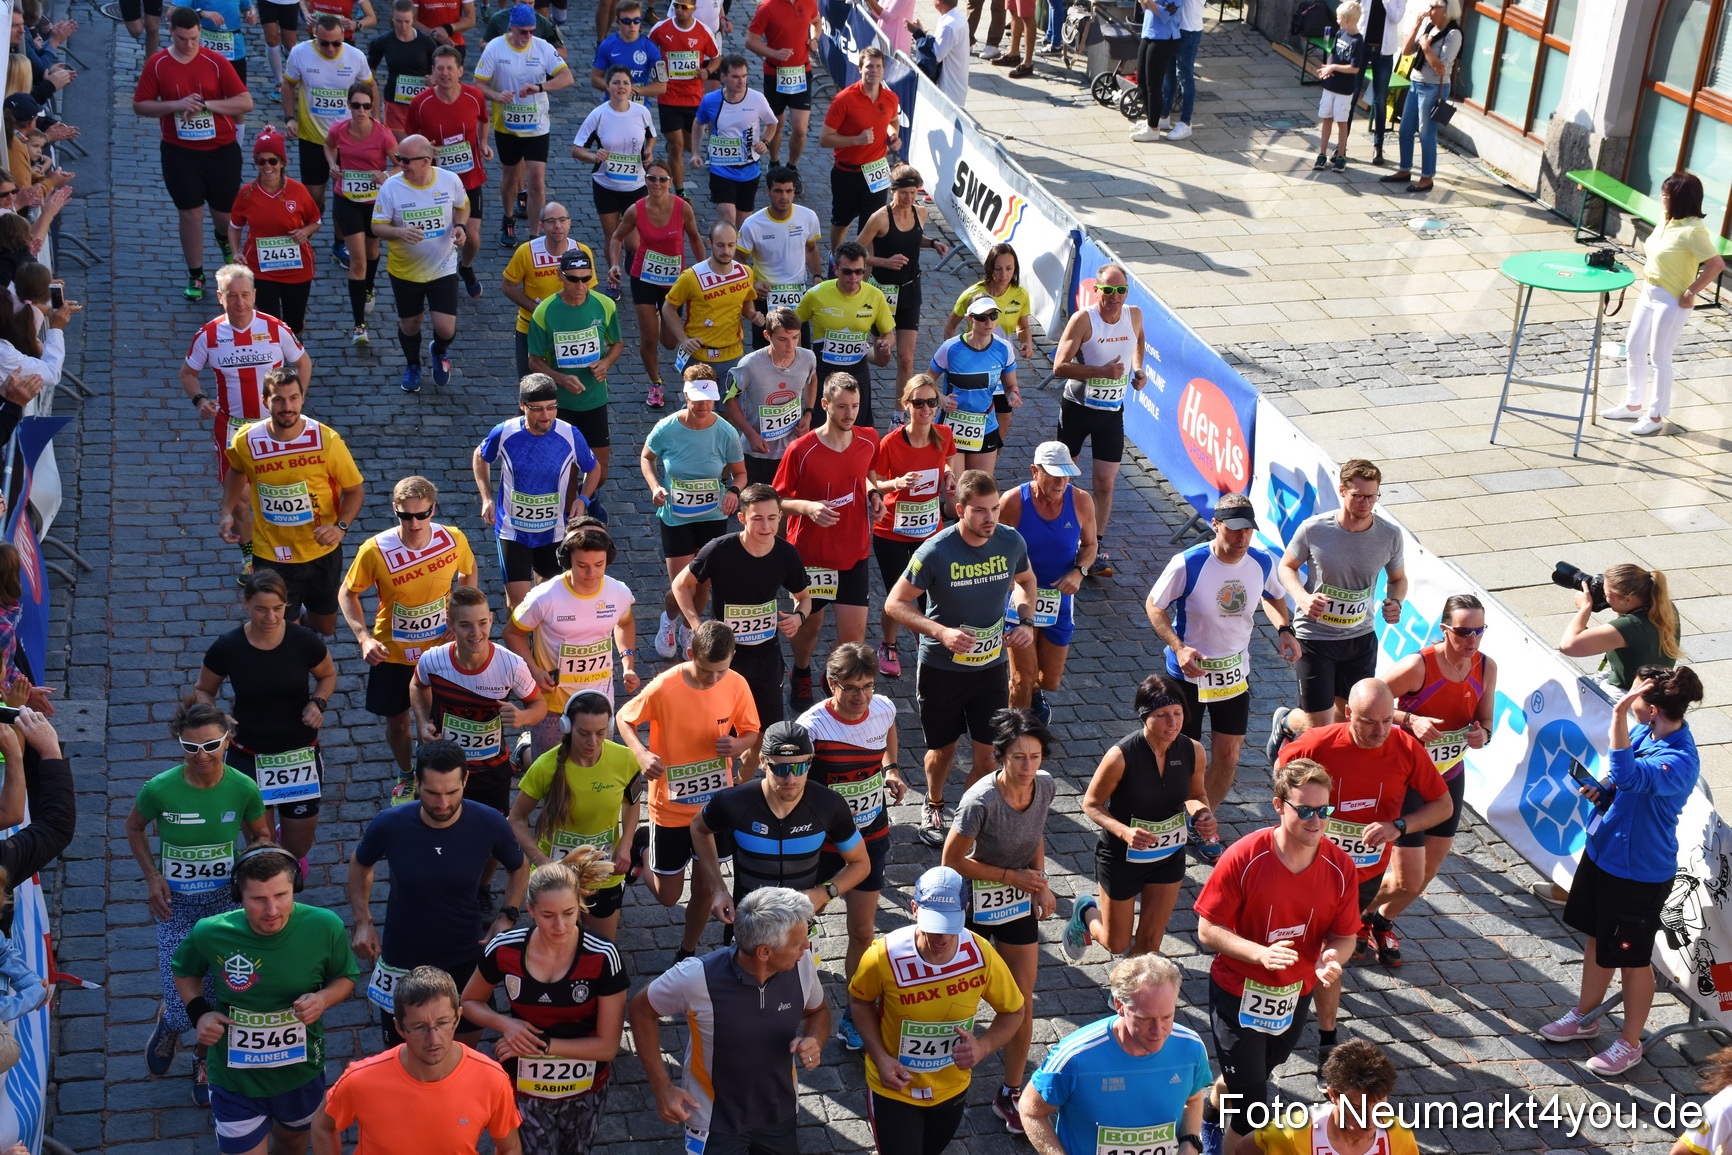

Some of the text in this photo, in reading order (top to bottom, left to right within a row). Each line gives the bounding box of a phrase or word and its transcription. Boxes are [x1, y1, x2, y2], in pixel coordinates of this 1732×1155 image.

[201, 31, 229, 40] BOCK
[203, 40, 230, 51] 2285
[669, 52, 698, 60] BOCK
[672, 61, 696, 70] 1248
[780, 76, 802, 86] 2031
[313, 89, 344, 97] BOCK
[315, 98, 344, 108] 2349
[506, 104, 534, 112] BOCK
[181, 119, 211, 130] 2568
[507, 113, 534, 123] 2817
[711, 138, 740, 146] BOCK
[609, 154, 639, 162] BOCK
[712, 147, 738, 157] 2192
[440, 153, 468, 166] 2569
[608, 162, 637, 174] 2773
[346, 182, 376, 192] 1298
[952, 160, 1003, 232] swn
[404, 209, 440, 219] BOCK
[260, 239, 293, 247] BOCK
[263, 248, 296, 261] 2443
[647, 252, 680, 264] BOCK
[535, 269, 559, 278] MAX
[646, 262, 677, 276] 2612
[703, 281, 750, 301] MAX BÖGL
[770, 284, 800, 292] BOCK
[771, 294, 800, 304] 2460
[558, 331, 596, 343] BOCK
[829, 331, 864, 341] BOCK
[560, 342, 596, 357] 2673
[829, 342, 861, 354] 2306
[218, 352, 273, 366] LAYENBERGER
[1092, 377, 1124, 386] BOCK
[1146, 367, 1166, 392] ONLINE
[1092, 388, 1123, 400] 2721
[763, 400, 799, 416] BOCK
[1139, 392, 1160, 421] MOBILE
[765, 411, 797, 430] 2165
[949, 411, 984, 424] BOCK
[949, 422, 981, 438] 1269
[1182, 383, 1245, 481] Hervis
[1189, 441, 1214, 471] SPORTS
[254, 455, 326, 475] MAX BÖGL
[261, 483, 301, 496] BOCK
[676, 480, 714, 491] BOCK
[264, 498, 305, 513] 2402
[515, 494, 556, 505] BOCK
[676, 492, 715, 505] 2758
[515, 506, 555, 520] 2255
[900, 501, 935, 513] BOCK
[514, 520, 554, 529] BERNHARD
[900, 513, 934, 527] 2561
[900, 526, 932, 535] SUSANNE
[391, 552, 459, 587] MAX BÖGL
[950, 555, 1008, 580] CrossFit
[950, 573, 1009, 588] FORGING ELITE FITNESS
[1326, 588, 1369, 602] BOCK
[396, 601, 443, 617] BOCK
[596, 602, 606, 610] 20
[730, 603, 773, 617] BOCK
[1327, 600, 1365, 616] 1140
[398, 614, 441, 631] 2407
[731, 616, 772, 634] 2325
[1322, 614, 1364, 625] CHRISTIAN
[405, 630, 437, 639] JULIAN
[735, 633, 766, 642] SAMUEL
[564, 640, 609, 657] BOCK
[970, 636, 1000, 655] 202
[566, 656, 607, 673] 1377
[965, 652, 994, 663] STEFAN
[1200, 655, 1241, 670] BOCK
[573, 671, 608, 683] VIKTOR
[1205, 668, 1242, 687] 1359
[450, 717, 497, 732] BOCK
[448, 731, 496, 749] 2326
[262, 751, 311, 766] BOCK
[671, 760, 721, 777] BOCK
[265, 766, 312, 786] 2677
[674, 774, 722, 798] 2533
[835, 776, 878, 795] BOCK
[686, 794, 710, 804] LUCA
[1328, 821, 1361, 837] BOC
[559, 832, 608, 846] BOCK
[168, 844, 227, 859] BOCK
[171, 862, 227, 879] 2348
[180, 881, 216, 891] MARIA
[981, 886, 1025, 909] 2330
[988, 906, 1019, 920] JUDITH
[899, 976, 987, 1005] MAX BÖGL
[1248, 995, 1293, 1016] 2584
[234, 1010, 296, 1026] BOCK
[237, 1028, 298, 1049] 2546
[909, 1023, 966, 1040] BOCK
[244, 1051, 289, 1062] RAINER
[909, 1057, 952, 1069] ANDREA
[528, 1062, 588, 1080] 1220
[534, 1083, 577, 1094] SABINE
[1105, 1129, 1167, 1144] BOCK
